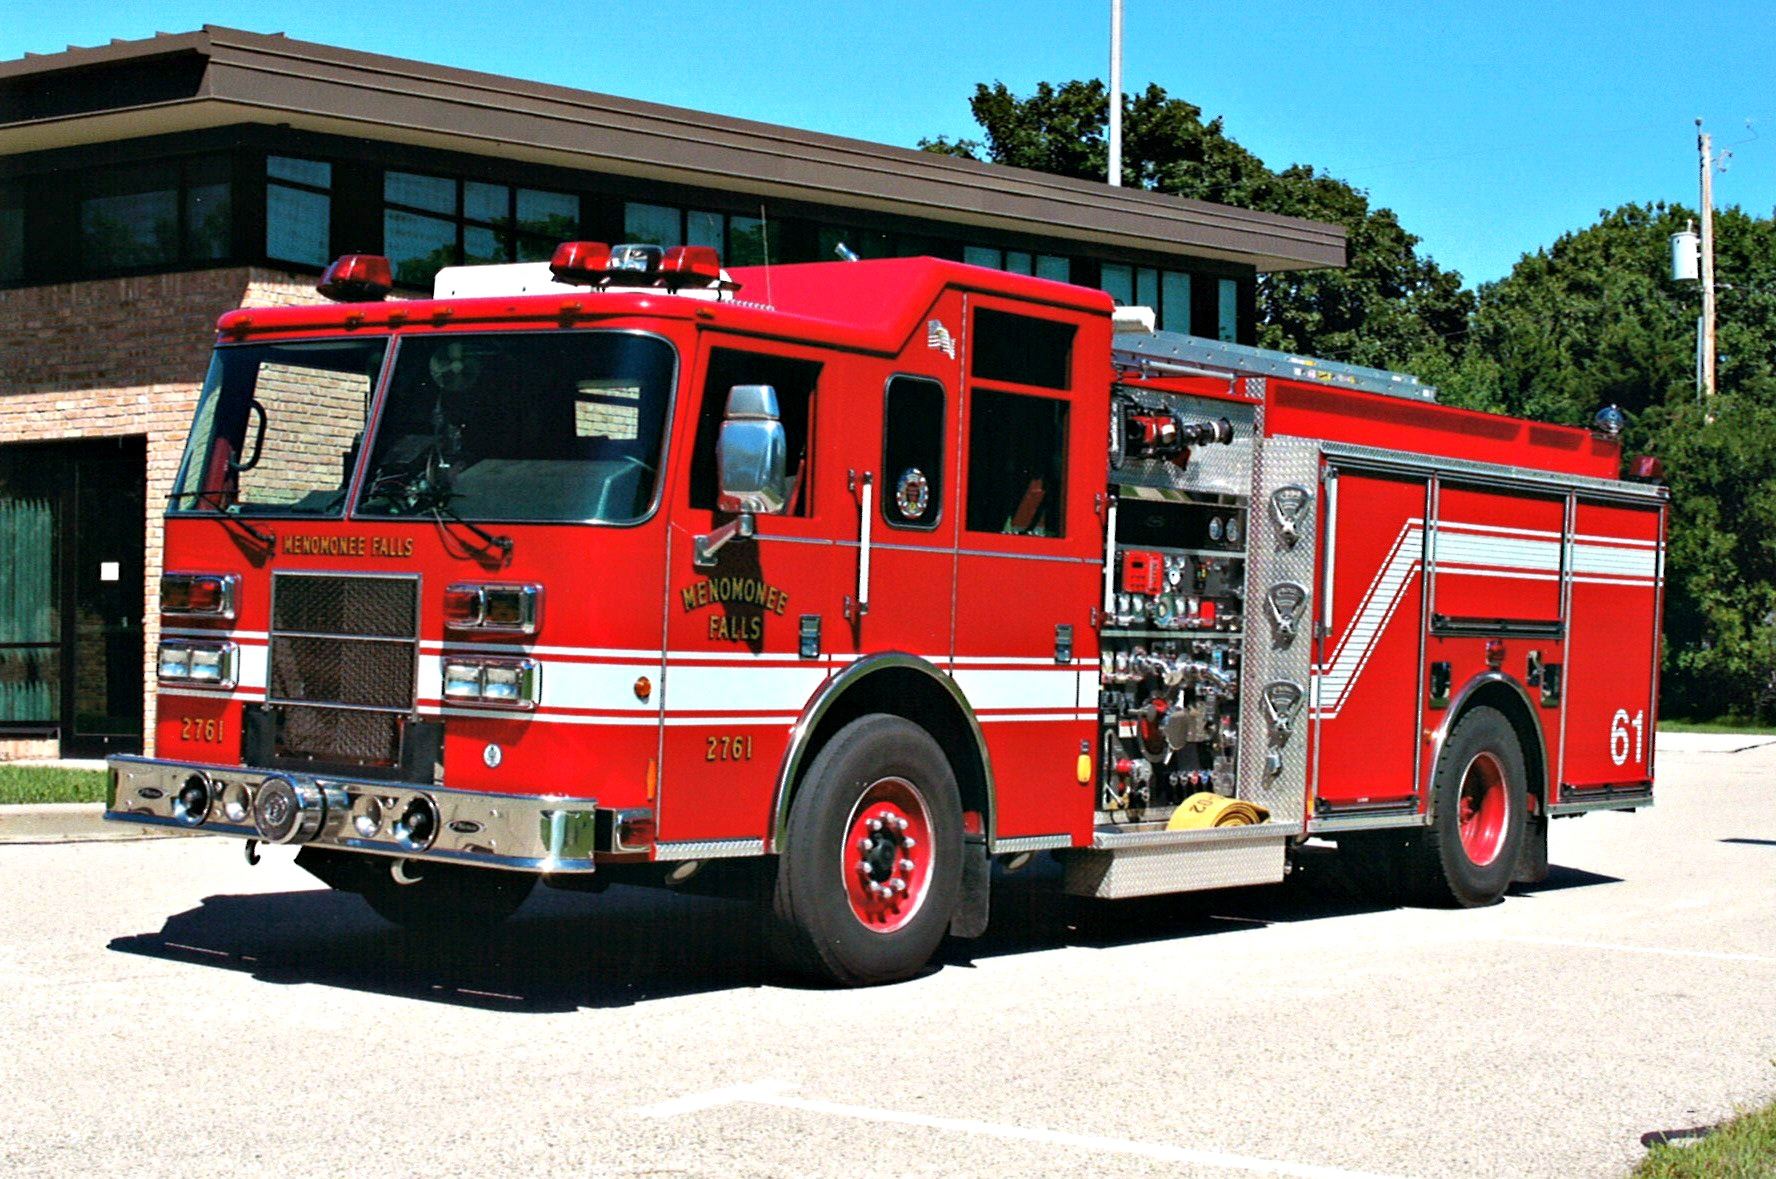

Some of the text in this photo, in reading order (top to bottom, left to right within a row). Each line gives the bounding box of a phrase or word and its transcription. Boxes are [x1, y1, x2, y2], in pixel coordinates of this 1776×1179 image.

[283, 535, 413, 557] MENOMONEE FALLS
[682, 577, 789, 615] MENOMONEE
[709, 615, 761, 641] FALLS
[181, 717, 224, 743] 2761
[1611, 708, 1643, 766] 61
[706, 735, 752, 761] 2761
